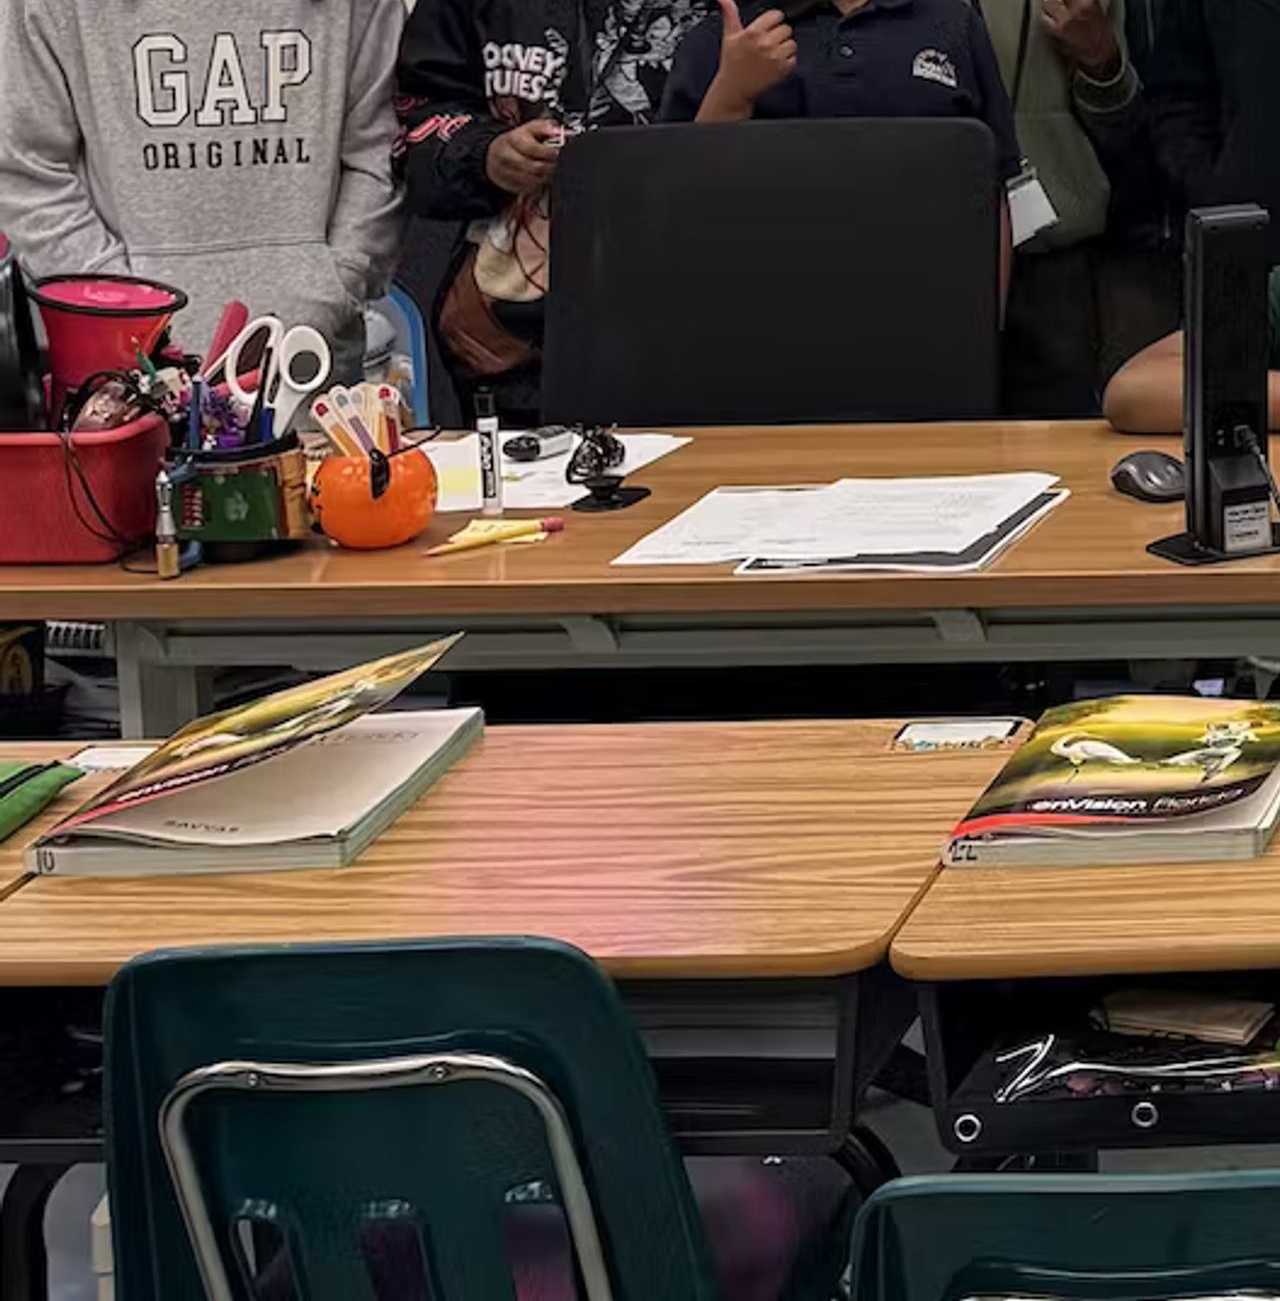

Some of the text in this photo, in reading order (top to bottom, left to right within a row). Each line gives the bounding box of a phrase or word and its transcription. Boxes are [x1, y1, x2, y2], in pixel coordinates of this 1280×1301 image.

[132, 29, 312, 127] GAP
[142, 137, 311, 171] ORIGINAL
[1032, 798, 1147, 814] enVision
